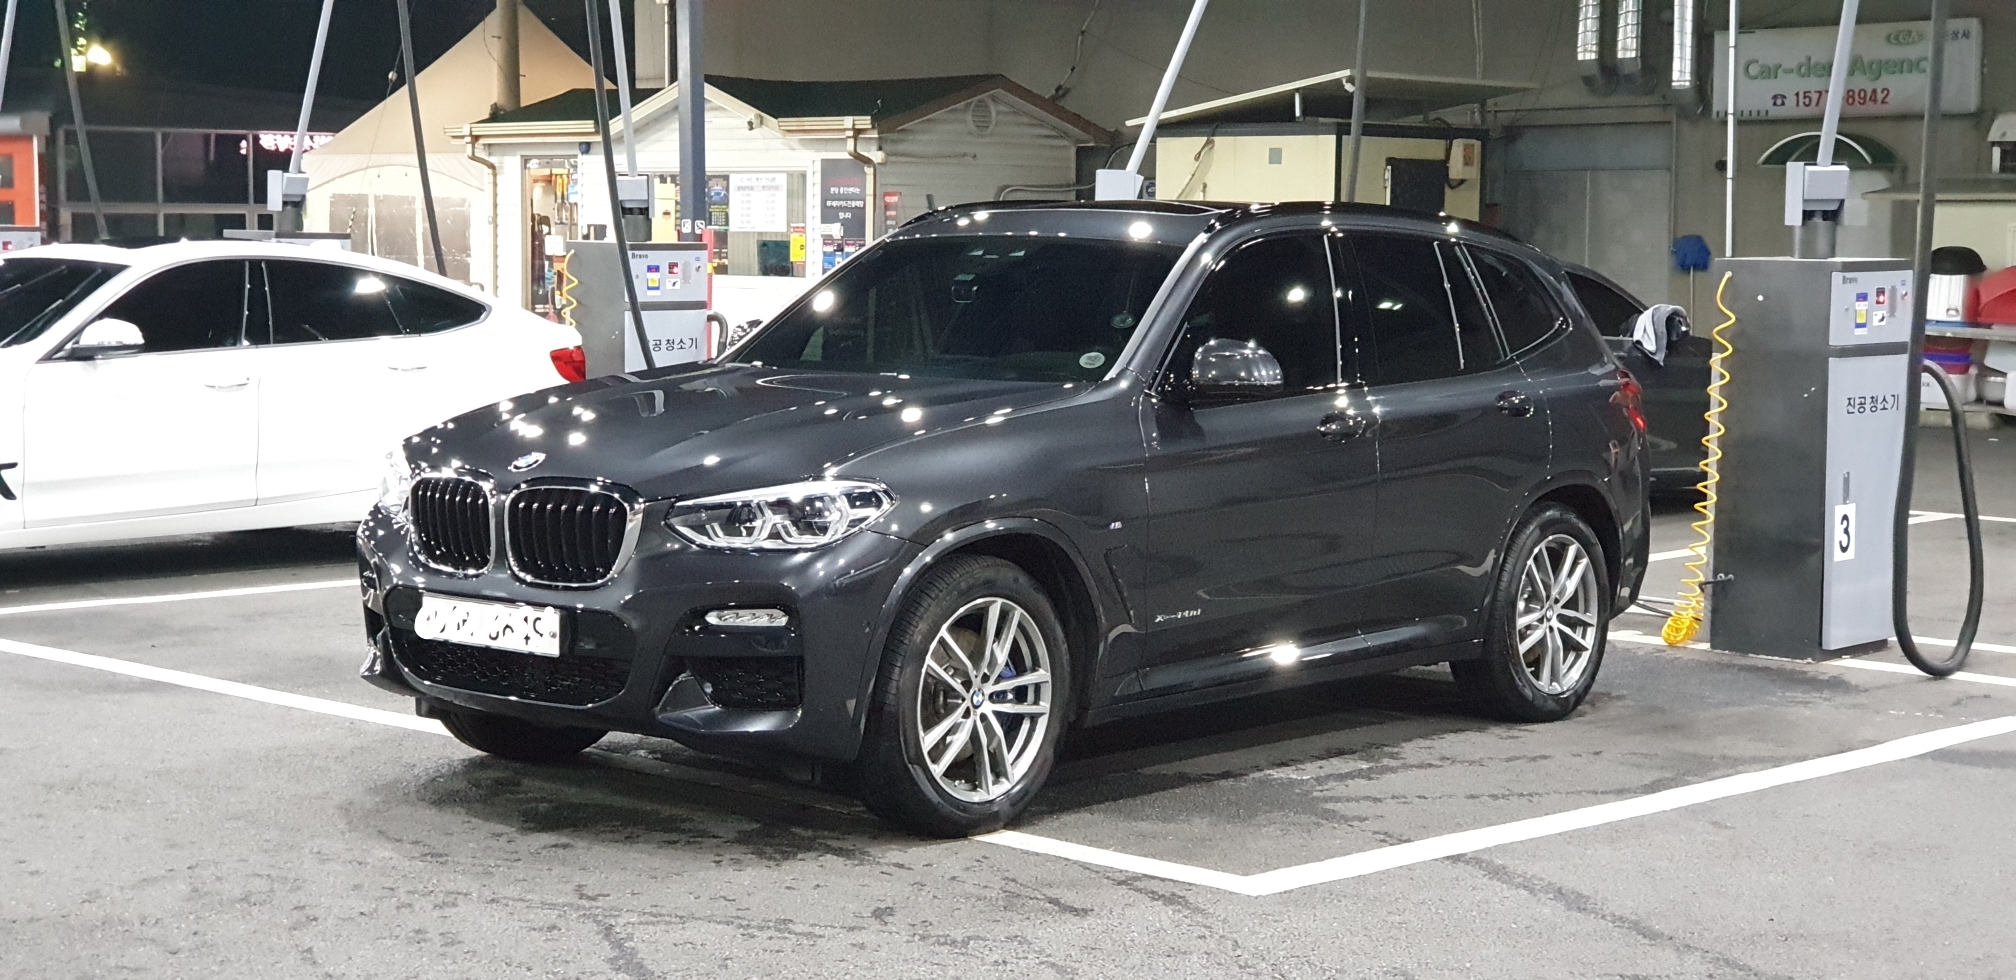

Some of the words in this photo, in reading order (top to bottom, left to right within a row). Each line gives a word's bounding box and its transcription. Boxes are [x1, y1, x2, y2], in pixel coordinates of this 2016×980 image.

[1849, 54, 1929, 81] Agenc
[631, 252, 649, 260] Bravo
[648, 337, 698, 352] 공청소기
[1846, 393, 1900, 415] 진공청소기
[1839, 513, 1851, 554] 3
